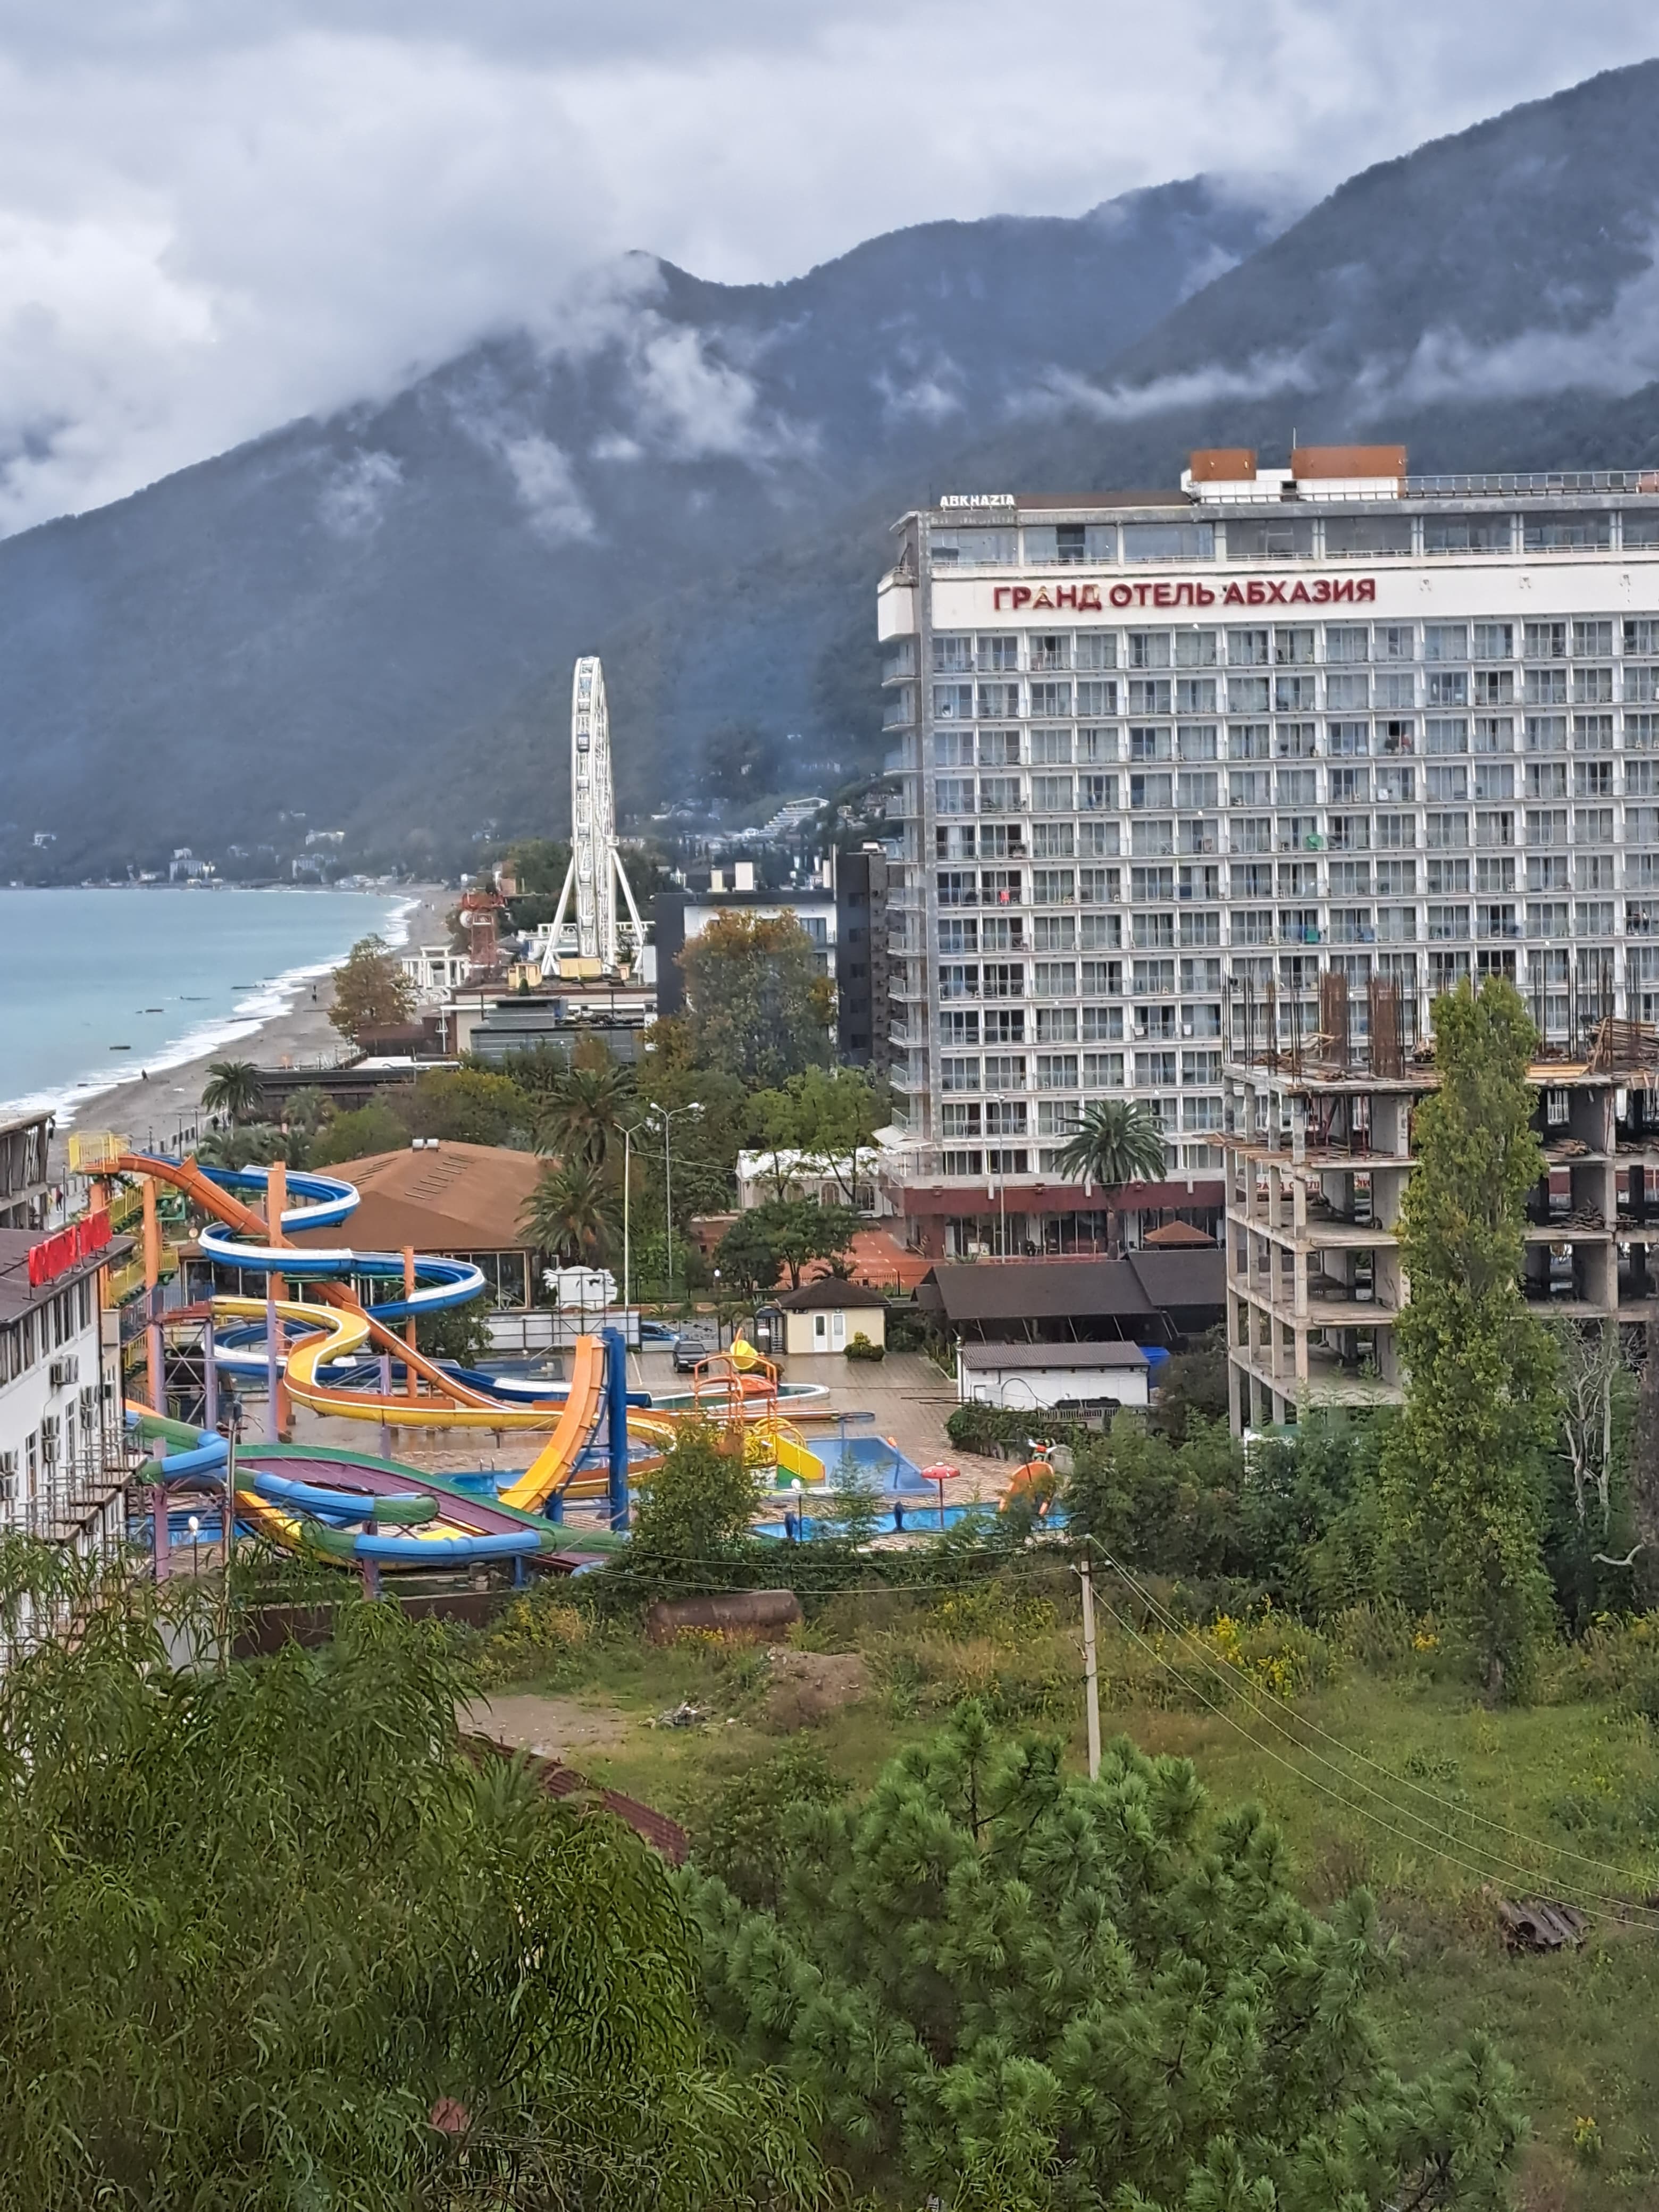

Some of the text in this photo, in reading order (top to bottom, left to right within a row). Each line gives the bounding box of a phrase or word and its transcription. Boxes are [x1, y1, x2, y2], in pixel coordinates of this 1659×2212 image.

[940, 495, 1015, 507] ABKHAZIA
[993, 578, 1376, 611] ГРАНД ОТЕЛЬ АБХАЗИЯ
